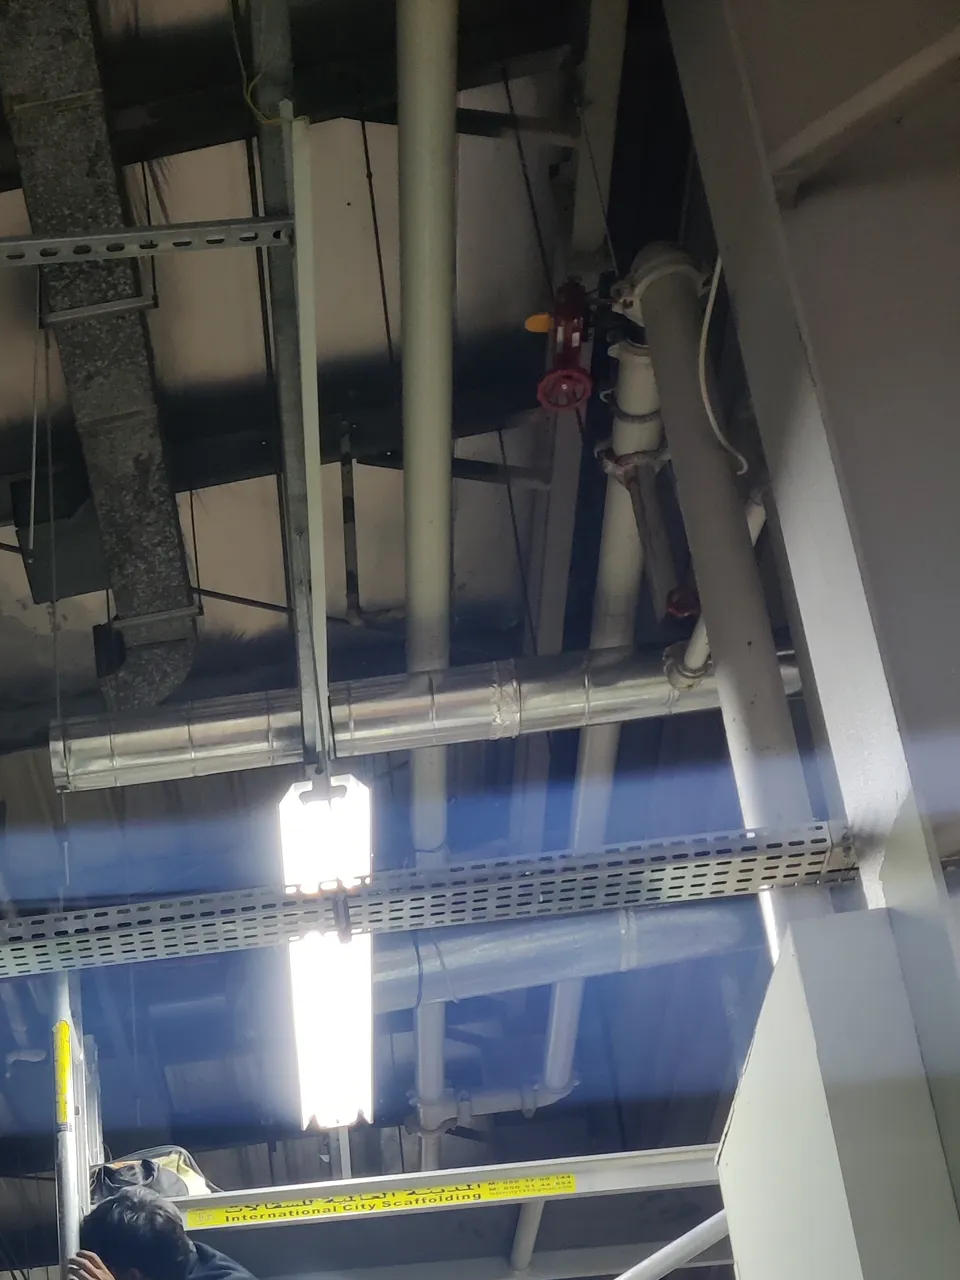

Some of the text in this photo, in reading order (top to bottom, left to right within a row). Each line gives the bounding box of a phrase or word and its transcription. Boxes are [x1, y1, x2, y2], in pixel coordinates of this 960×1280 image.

[225, 1205, 337, 1222] International
[342, 1202, 376, 1212] City
[381, 1193, 482, 1208] Scaffolding
